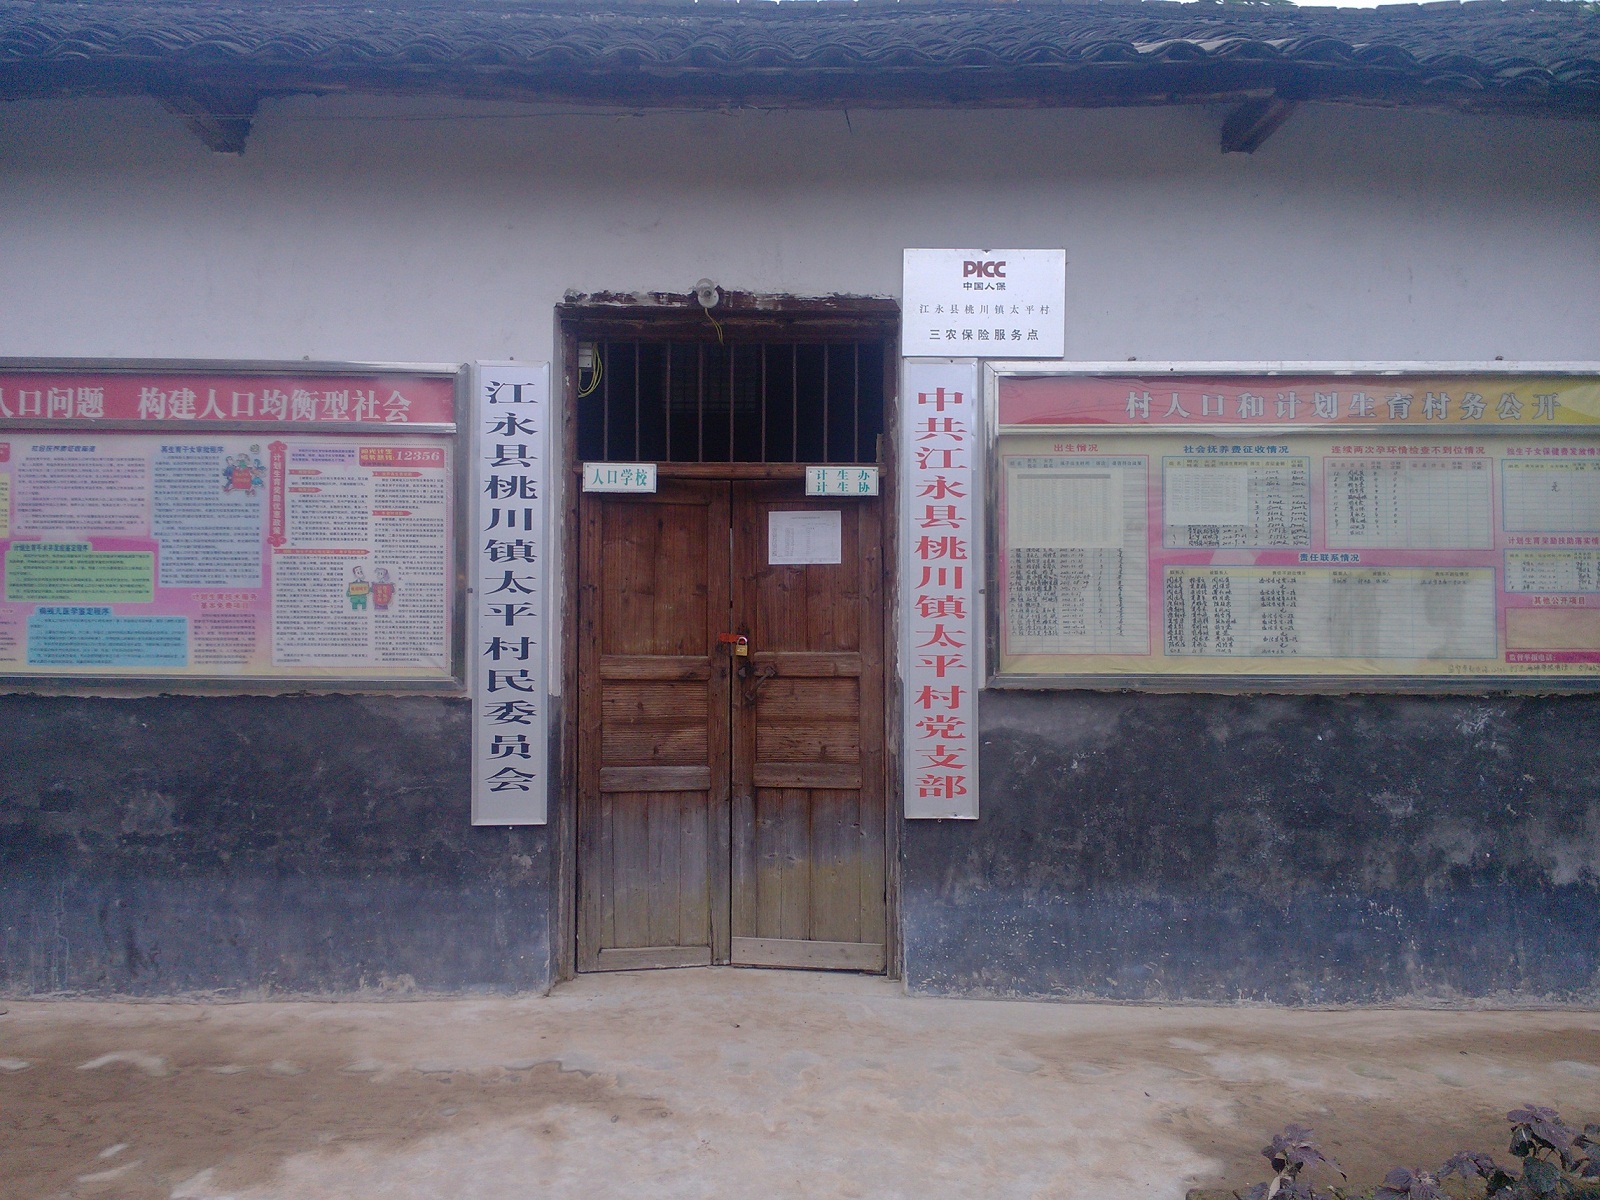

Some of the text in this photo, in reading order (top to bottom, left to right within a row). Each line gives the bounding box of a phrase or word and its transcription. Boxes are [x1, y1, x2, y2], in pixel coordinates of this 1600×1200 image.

[963, 261, 1006, 277] PICC
[963, 282, 1006, 291] 中国人保
[919, 304, 1050, 315] 江永县桃川镇太平村
[929, 329, 1039, 341] 三农保险服务点
[137, 387, 411, 422] 构建人口均衡型社会
[1125, 391, 1562, 420] 村人口和计划生育村务公开
[161, 445, 224, 453] 再生育子女审批程序
[1054, 443, 1099, 452] 出生情况
[1183, 445, 1290, 454] 社会抚养费征收情况
[1331, 445, 1486, 455] 连续两次孕环情检查不到位情况
[397, 450, 440, 461] 12356
[591, 468, 648, 487] 人口学校
[816, 470, 870, 481] 计生办
[816, 481, 870, 493] 计生协
[273, 453, 282, 535] 计划生育奖励优惠政策
[1299, 553, 1360, 561] 责任联系情况
[484, 380, 538, 793] 江永县桃川镇太平村民委员会
[914, 386, 968, 799] 中共江永县桃川镇太平村党支部
[1534, 596, 1586, 605] 其他公开项目
